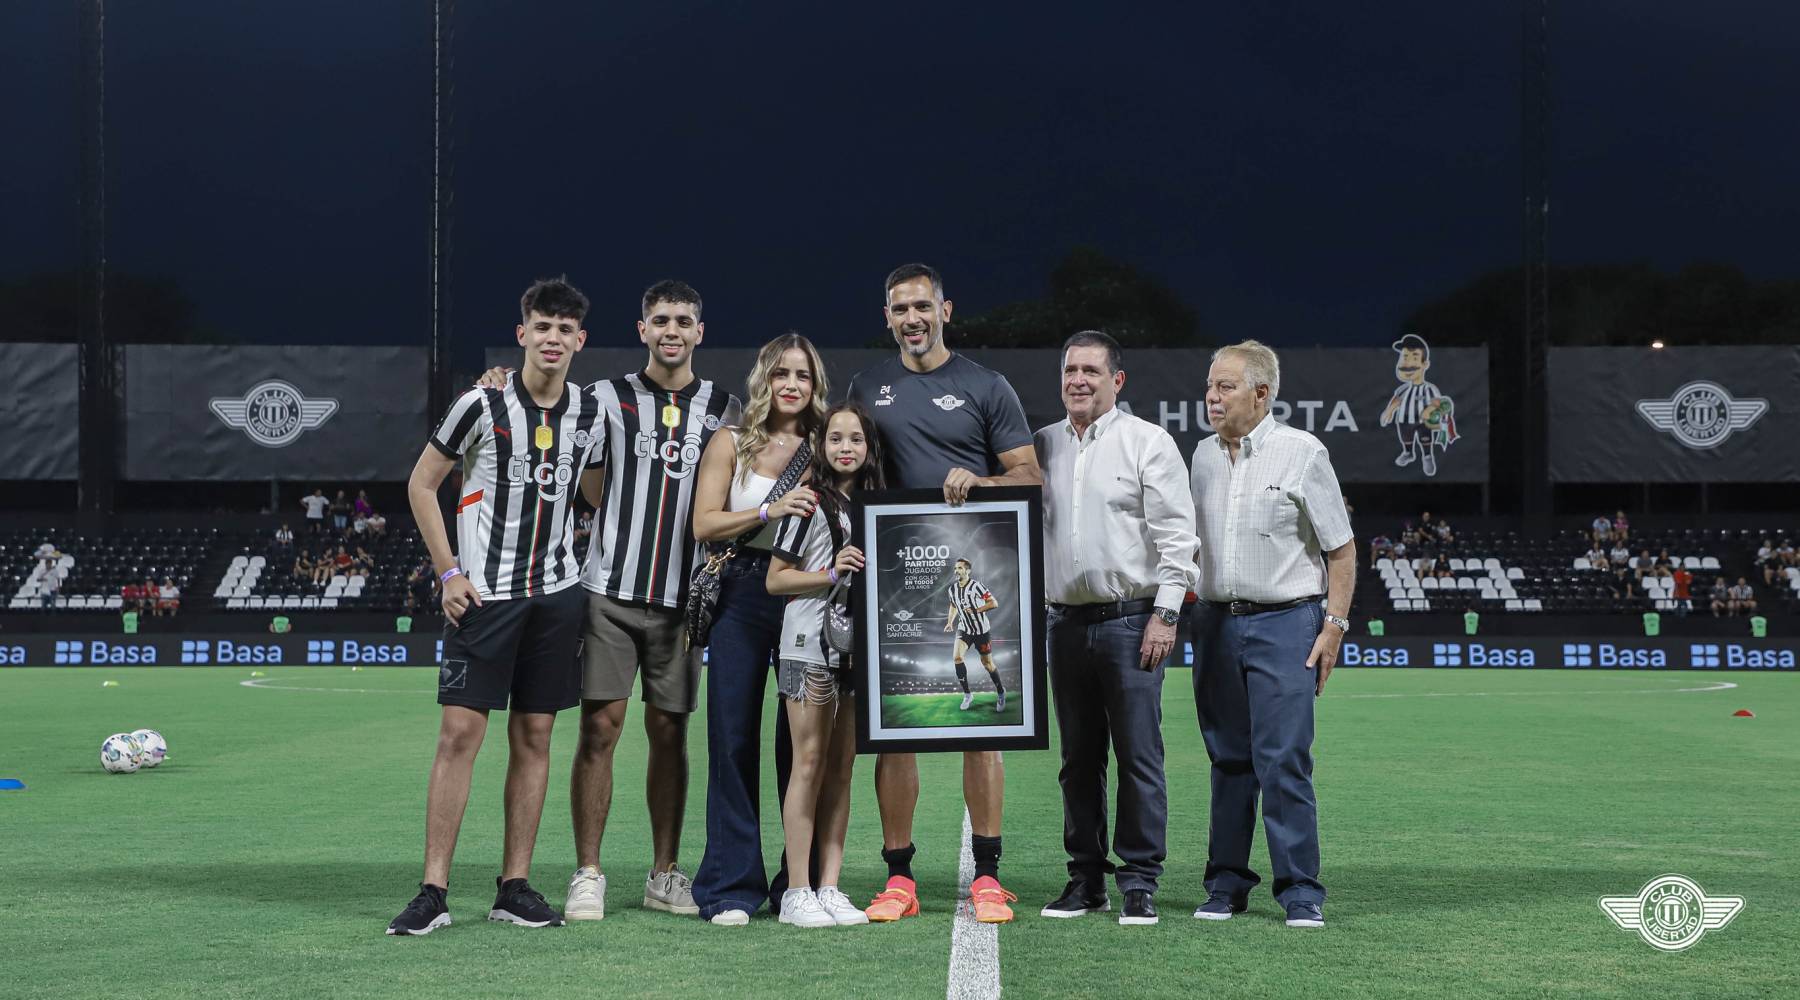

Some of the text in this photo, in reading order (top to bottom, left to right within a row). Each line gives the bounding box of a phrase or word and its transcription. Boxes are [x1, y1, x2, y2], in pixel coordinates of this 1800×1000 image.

[255, 389, 293, 406] CLUB
[880, 385, 891, 394] 24
[1682, 391, 1721, 407] CLUB
[1159, 400, 1360, 432] HURTA
[251, 416, 297, 437] LIBERTAD
[1680, 417, 1725, 438] LIBERTAD
[896, 545, 950, 560] +1000
[905, 559, 946, 567] PARTIDOS
[886, 622, 922, 632] ROQUE
[90, 641, 157, 664] Basa
[216, 640, 283, 663] Basa
[342, 640, 408, 663] Basa
[1343, 643, 1409, 666] Basa
[1468, 644, 1535, 667] Basa
[1599, 644, 1667, 667] Basa
[1726, 645, 1795, 668] Basa
